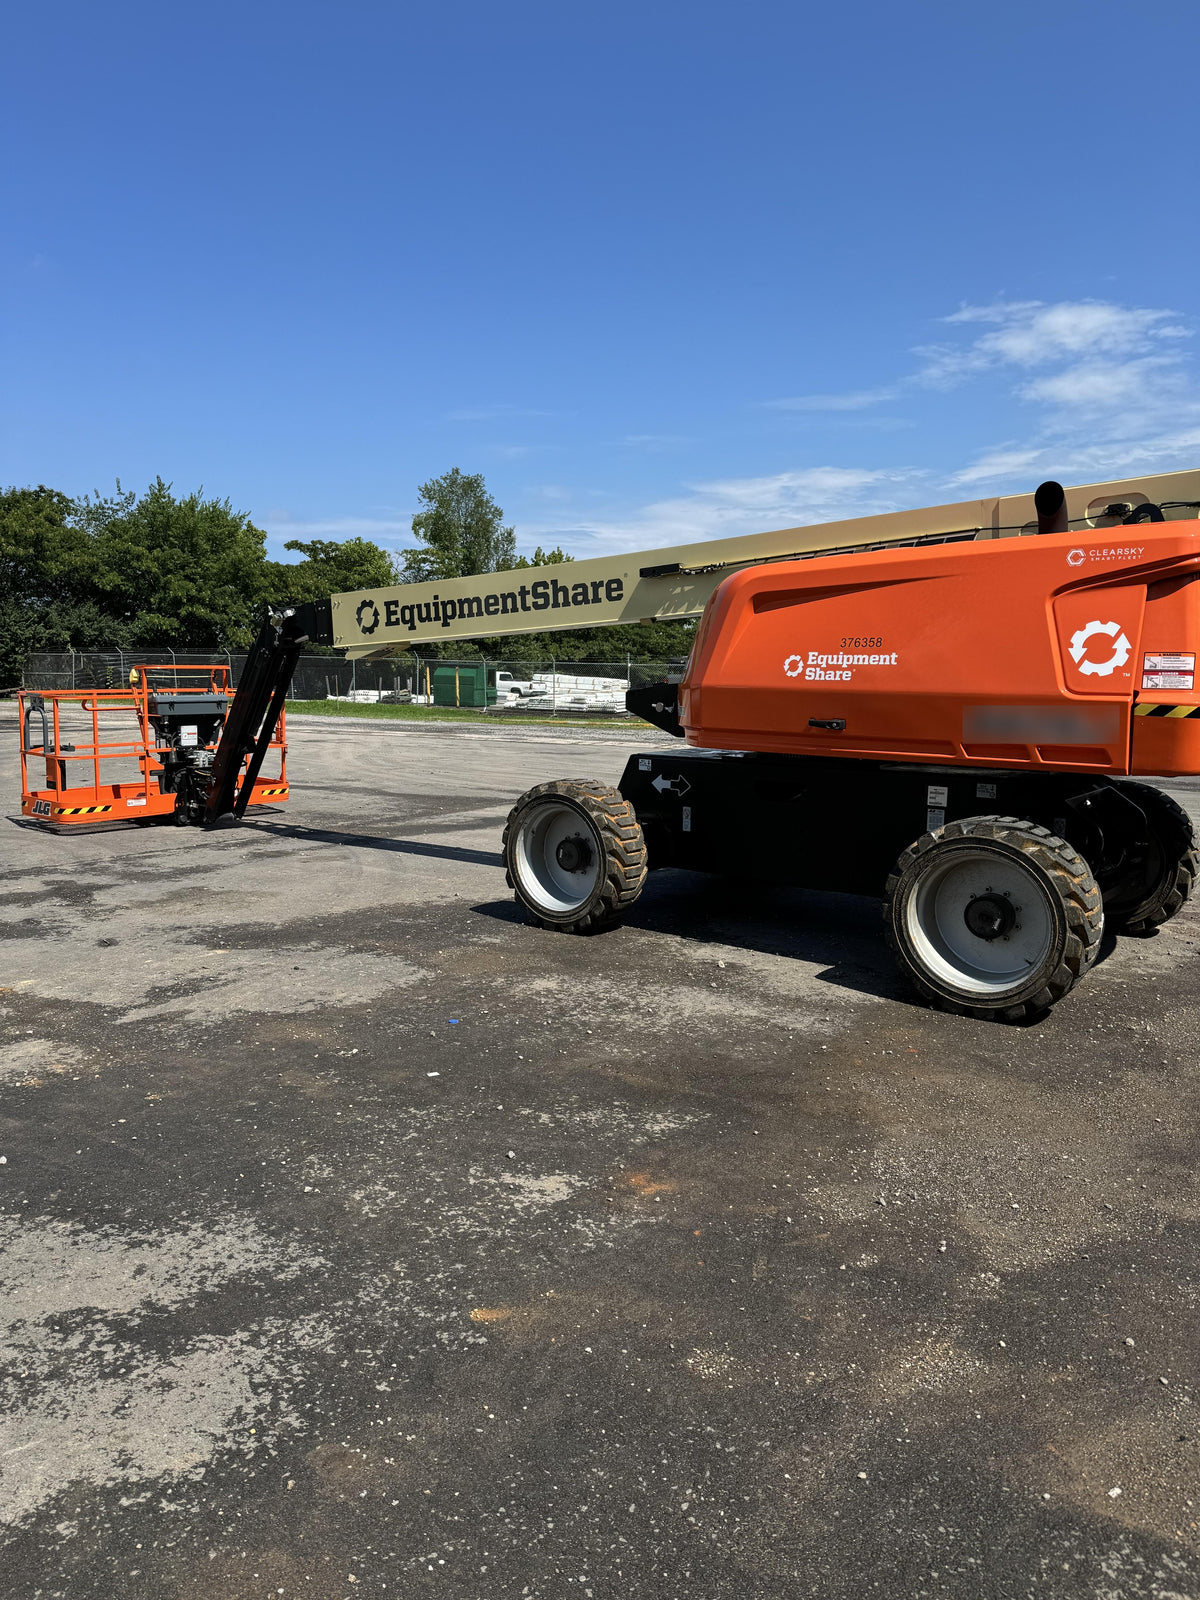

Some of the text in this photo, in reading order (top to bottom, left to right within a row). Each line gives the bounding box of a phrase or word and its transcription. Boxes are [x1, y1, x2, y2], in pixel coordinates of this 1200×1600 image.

[1089, 547, 1145, 556] CLEARSKY
[384, 578, 624, 630] EquipmentShare
[840, 637, 882, 648] 376358
[807, 652, 898, 668] Equipment
[805, 667, 852, 681] Share
[32, 800, 51, 816] JLG
